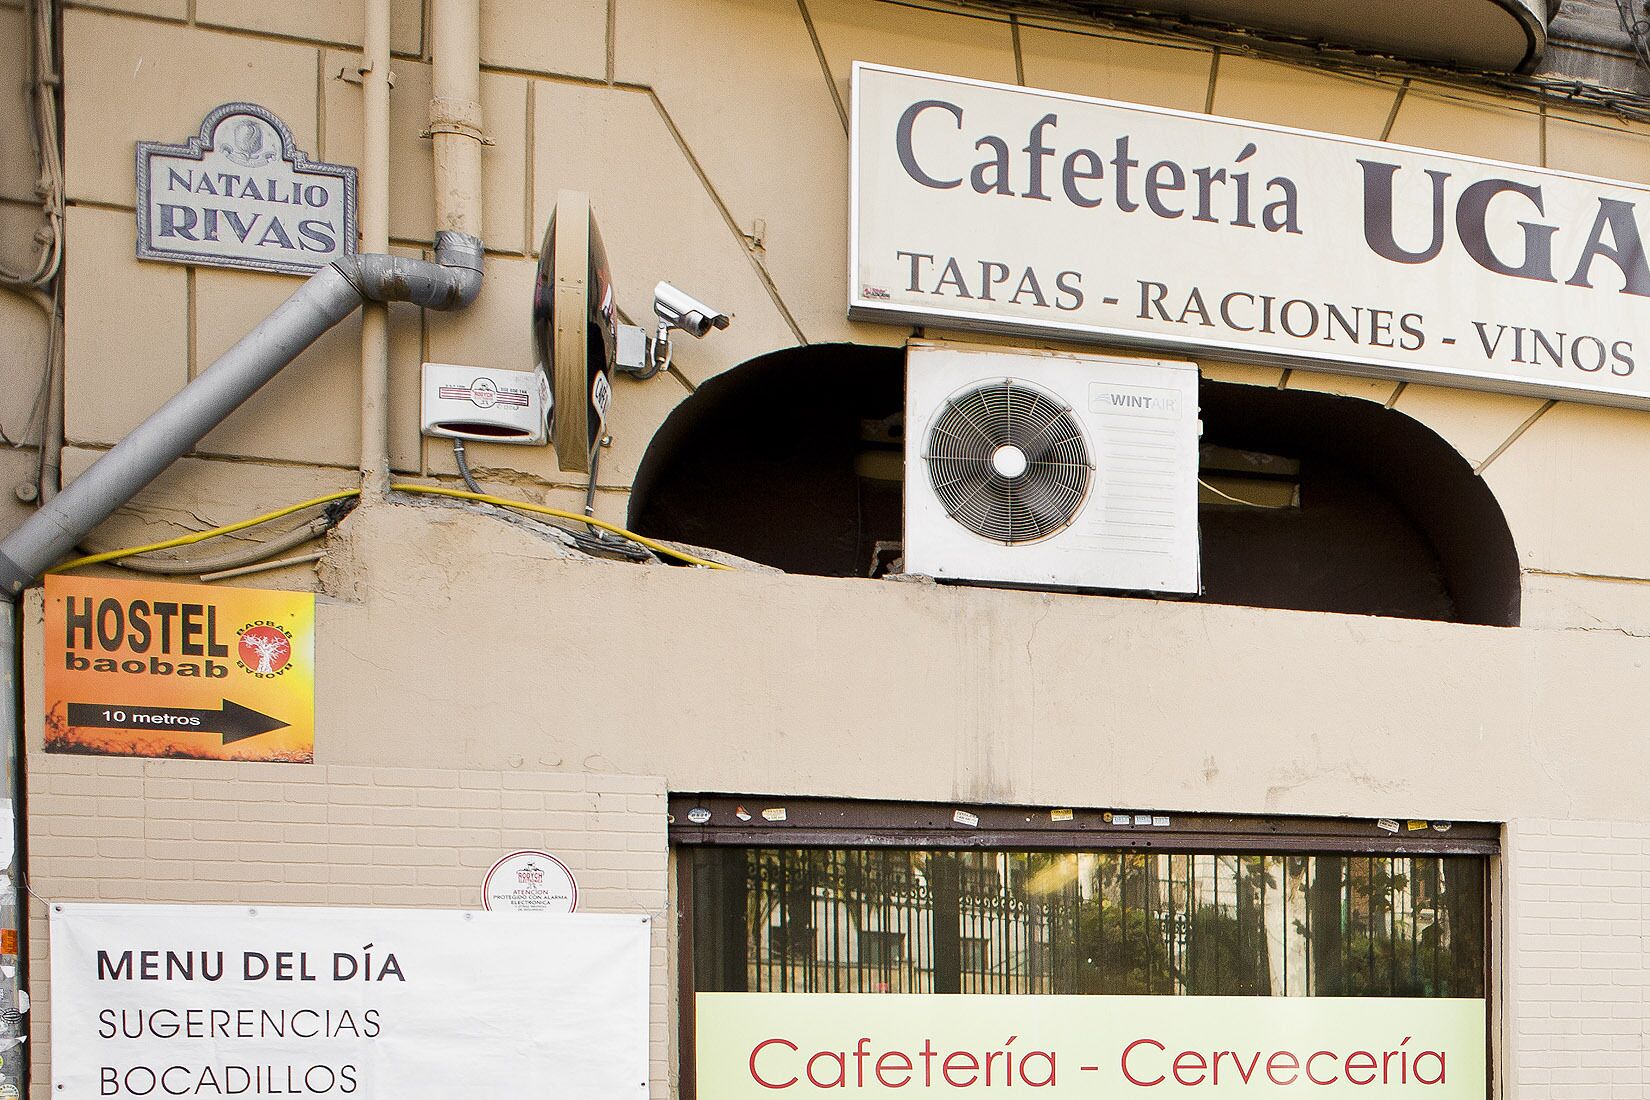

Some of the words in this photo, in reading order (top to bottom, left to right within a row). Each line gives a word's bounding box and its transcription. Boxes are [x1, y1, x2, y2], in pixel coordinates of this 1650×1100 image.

[896, 99, 1304, 235] Cafetería
[168, 167, 329, 208] NATALIO
[157, 203, 336, 253] RIVAS
[896, 251, 1083, 312] TAPAS
[1135, 280, 1424, 352] RACIONES
[1471, 322, 1635, 377] VINOS
[66, 596, 229, 658] HOSTEL
[236, 620, 293, 641] BAOBAB
[66, 652, 230, 680] baobab
[103, 711, 126, 721] 10
[132, 713, 201, 726] metros
[98, 951, 223, 981] MENU
[244, 952, 315, 980] DEL
[333, 943, 405, 981] DÍA
[99, 1009, 379, 1038] SUGERENCIAS
[101, 1065, 356, 1095] BOCADILLOS
[749, 1036, 1055, 1089] Cafetería
[1122, 1037, 1445, 1086] Cervecería
